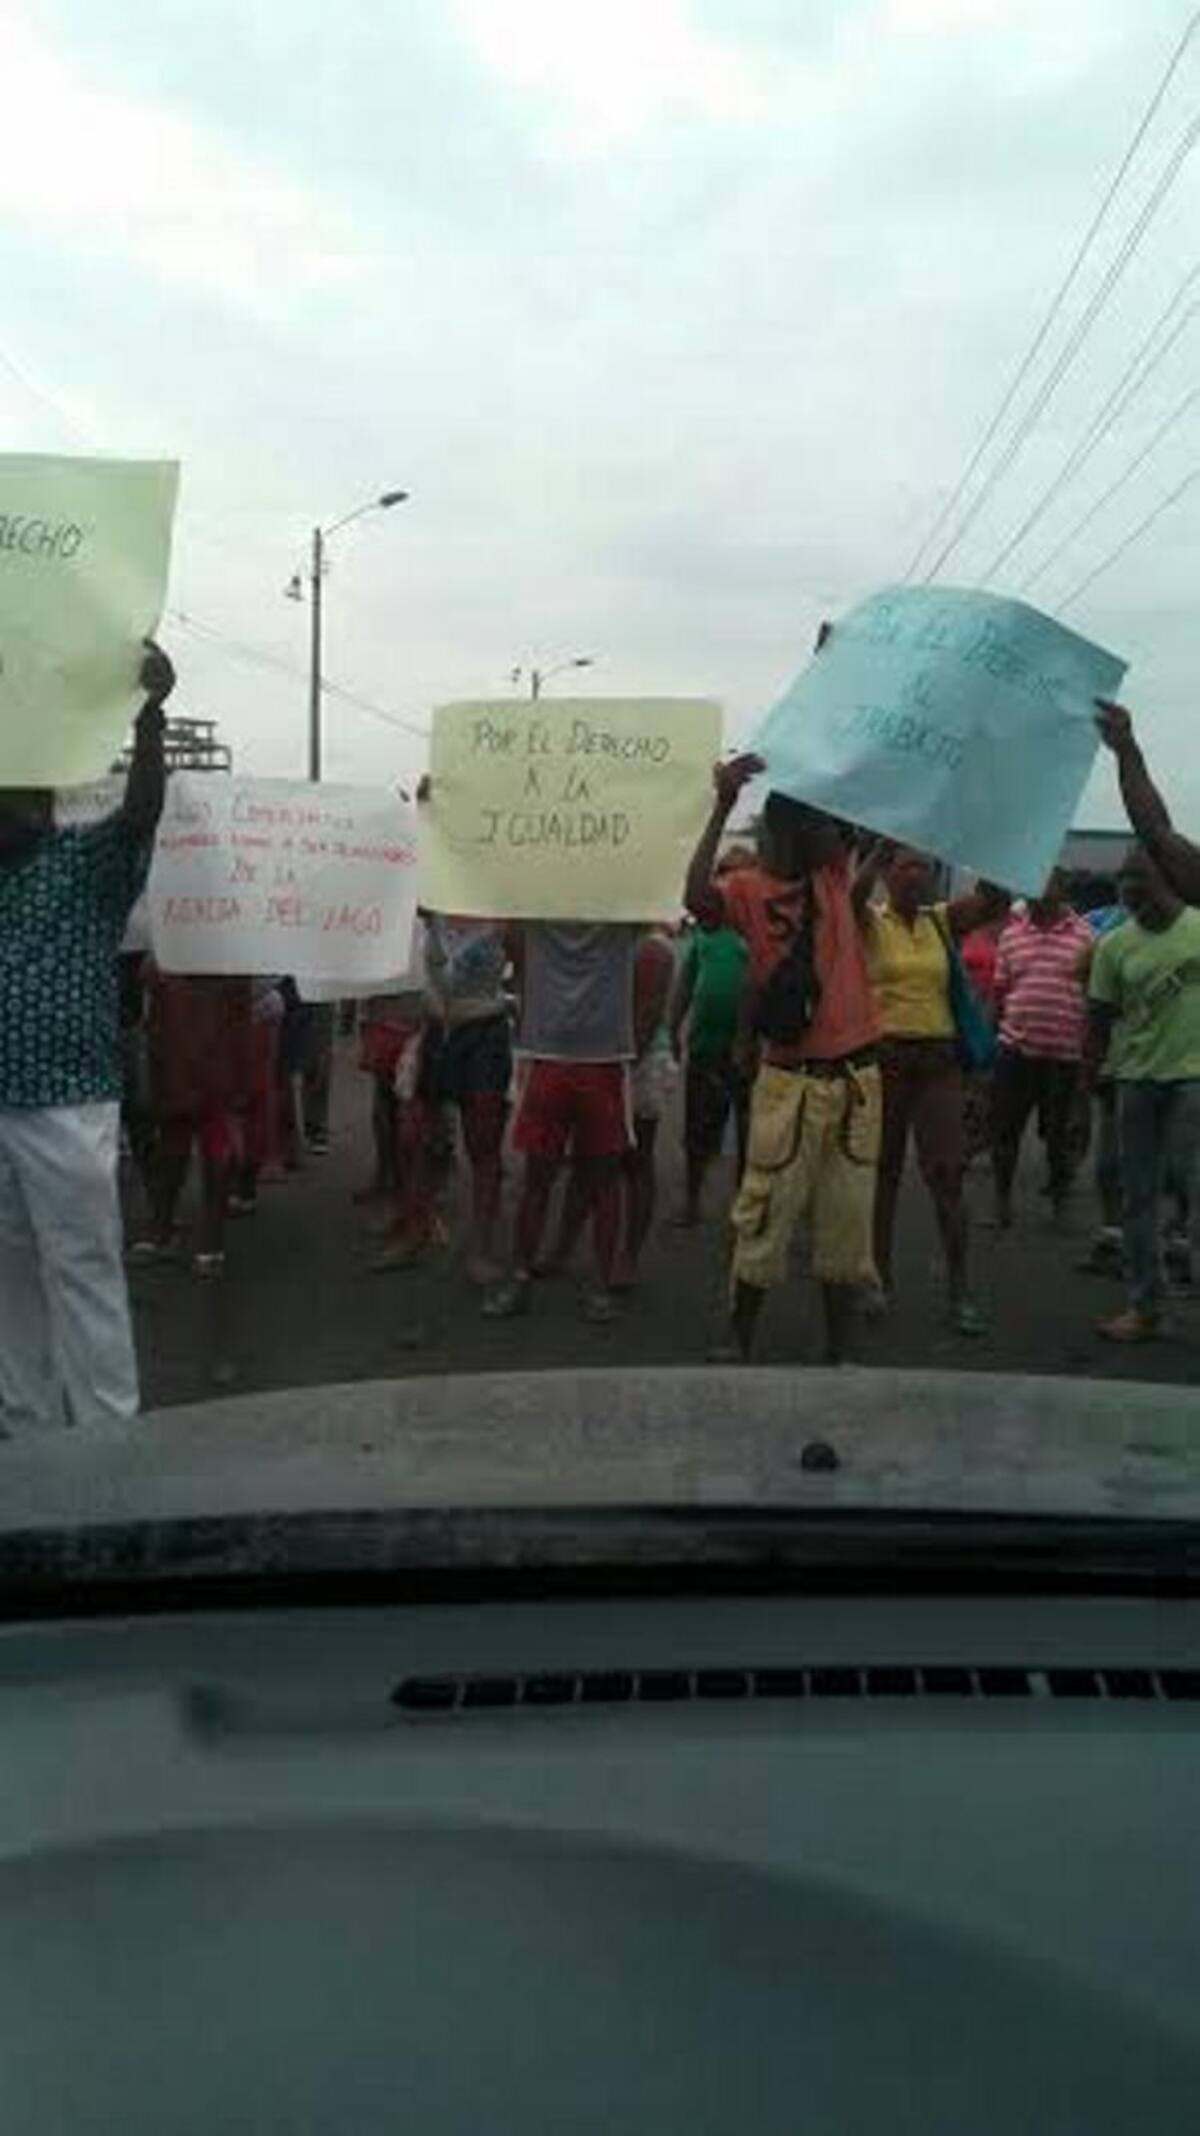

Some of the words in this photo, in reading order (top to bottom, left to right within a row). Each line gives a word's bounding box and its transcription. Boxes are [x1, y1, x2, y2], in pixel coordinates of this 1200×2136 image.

[471, 719, 518, 753] POR
[527, 724, 552, 754] EL
[570, 720, 671, 763] DERECHO
[523, 766, 541, 799] A
[563, 766, 590, 802] LA
